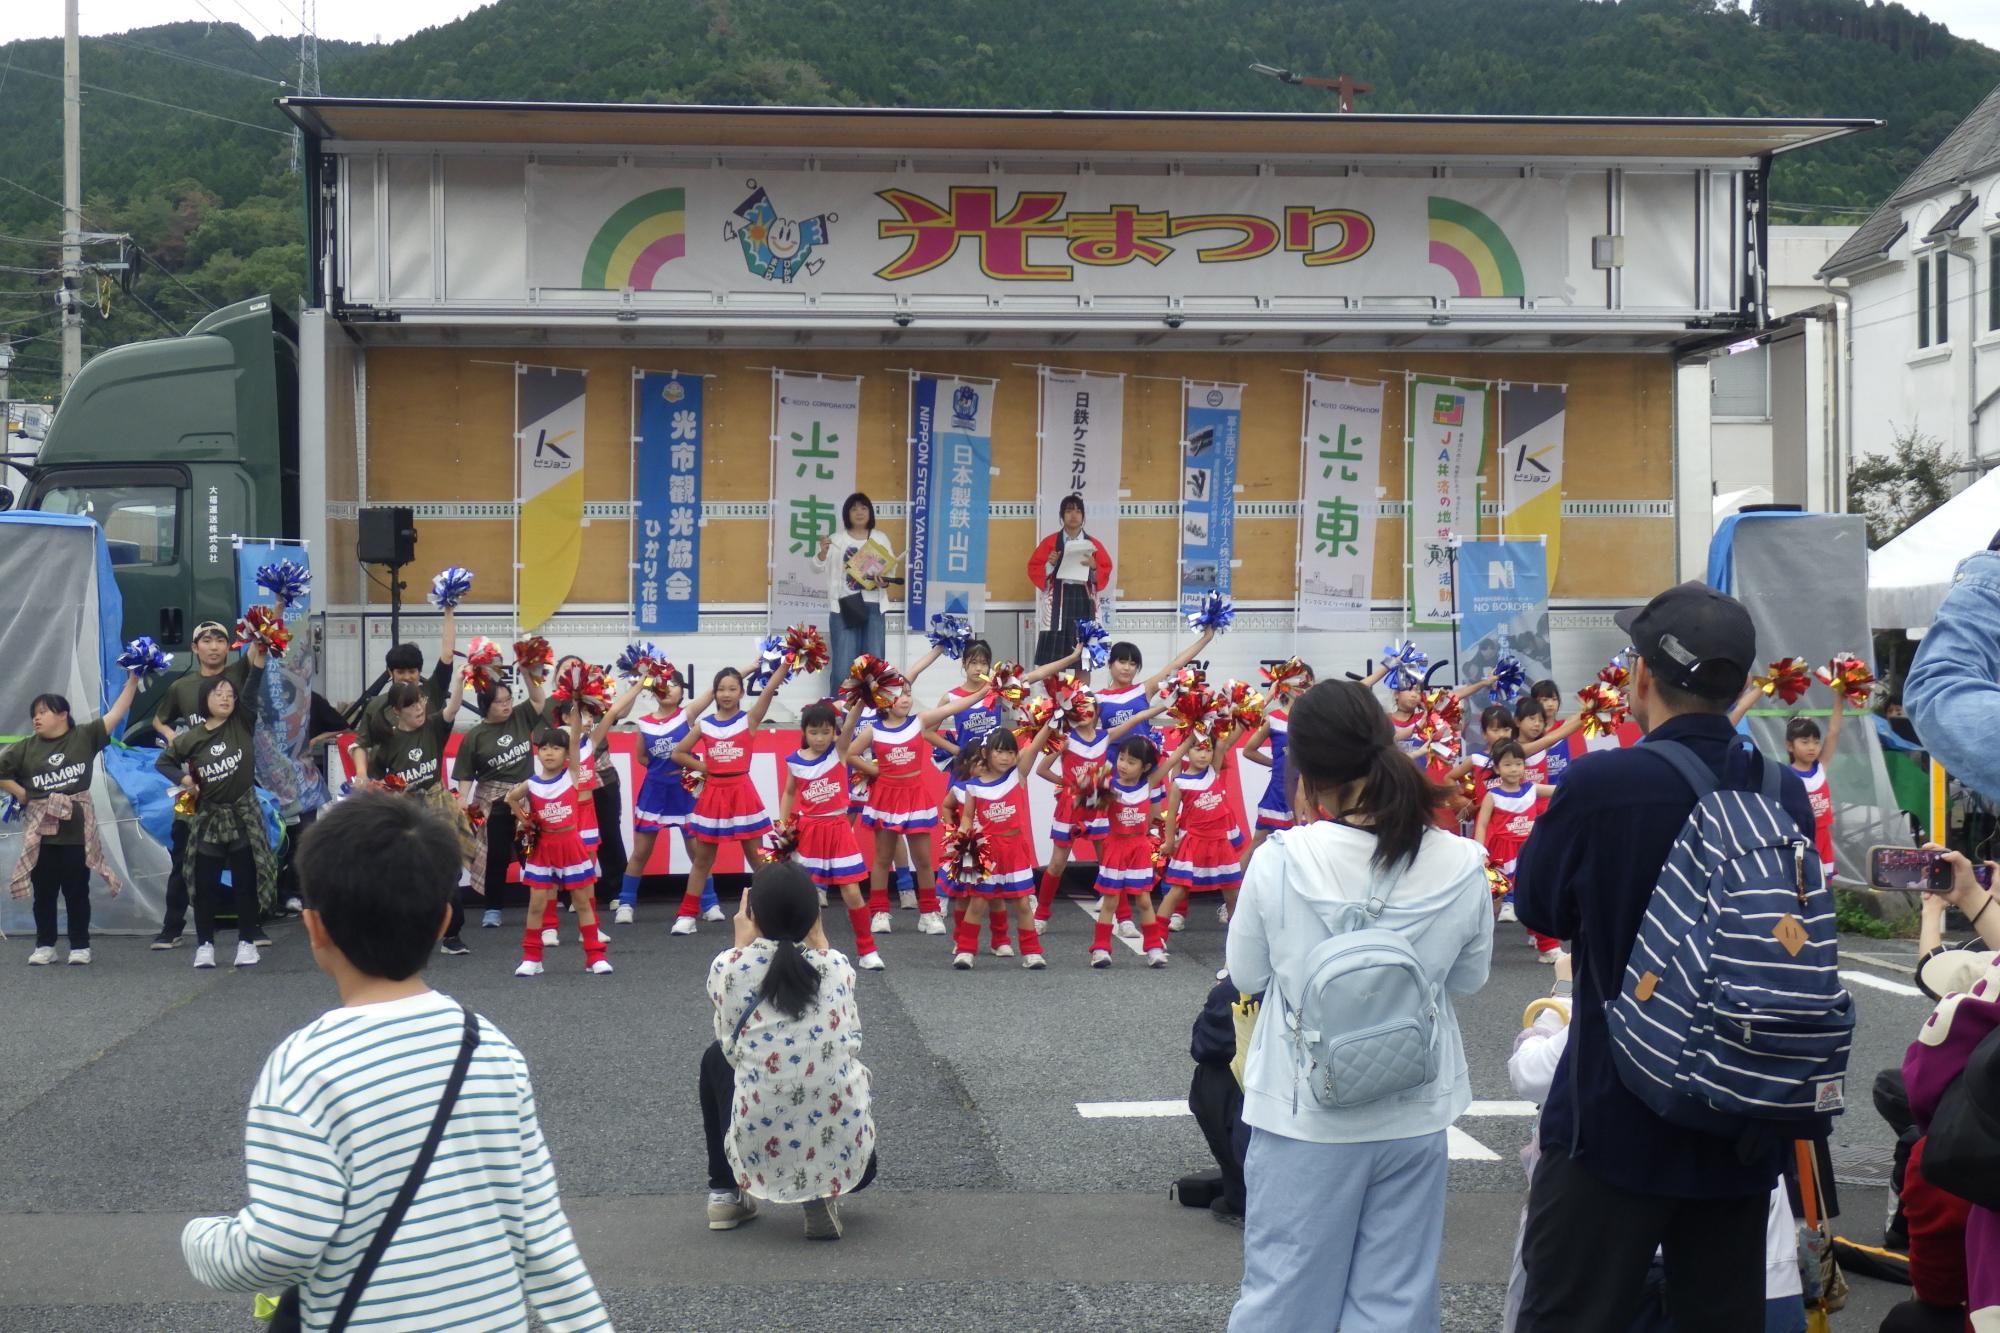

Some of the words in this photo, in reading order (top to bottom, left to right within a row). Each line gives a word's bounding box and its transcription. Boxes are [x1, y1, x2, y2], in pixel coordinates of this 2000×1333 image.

[873, 186, 1374, 281] 光まつり
[812, 400, 857, 410] CORPORATION
[918, 406, 930, 463] NIPPON
[533, 458, 572, 469] ビジョン
[1513, 472, 1552, 483] ビジョン
[788, 420, 840, 559] 光東
[915, 466, 927, 513] STEEL
[1314, 423, 1364, 559] 光東
[666, 409, 697, 602] 光市観光協会
[947, 443, 973, 573] 日本製鉄山口
[913, 515, 925, 605] YAMAGUCHI
[641, 519, 662, 625] ひかり花館
[1473, 603, 1490, 612] NO
[1492, 602, 1534, 612] BORDER
[969, 711, 987, 721] SKY
[1116, 708, 1133, 717] SKY
[963, 716, 997, 730] WALKERS
[655, 736, 673, 746] SKY
[715, 741, 735, 750] SKY
[488, 740, 530, 767] DIAMOND
[708, 747, 744, 757] WALKERS
[885, 751, 916, 762] WALKERS
[891, 746, 909, 754] SKY
[32, 762, 86, 788] DIAMOND
[809, 777, 829, 789] SKY
[802, 781, 841, 801] WALKERS
[538, 805, 573, 819] WALKERS
[544, 801, 562, 811] SKY
[982, 805, 1016, 819] WALKERS
[989, 801, 1006, 810] SKY
